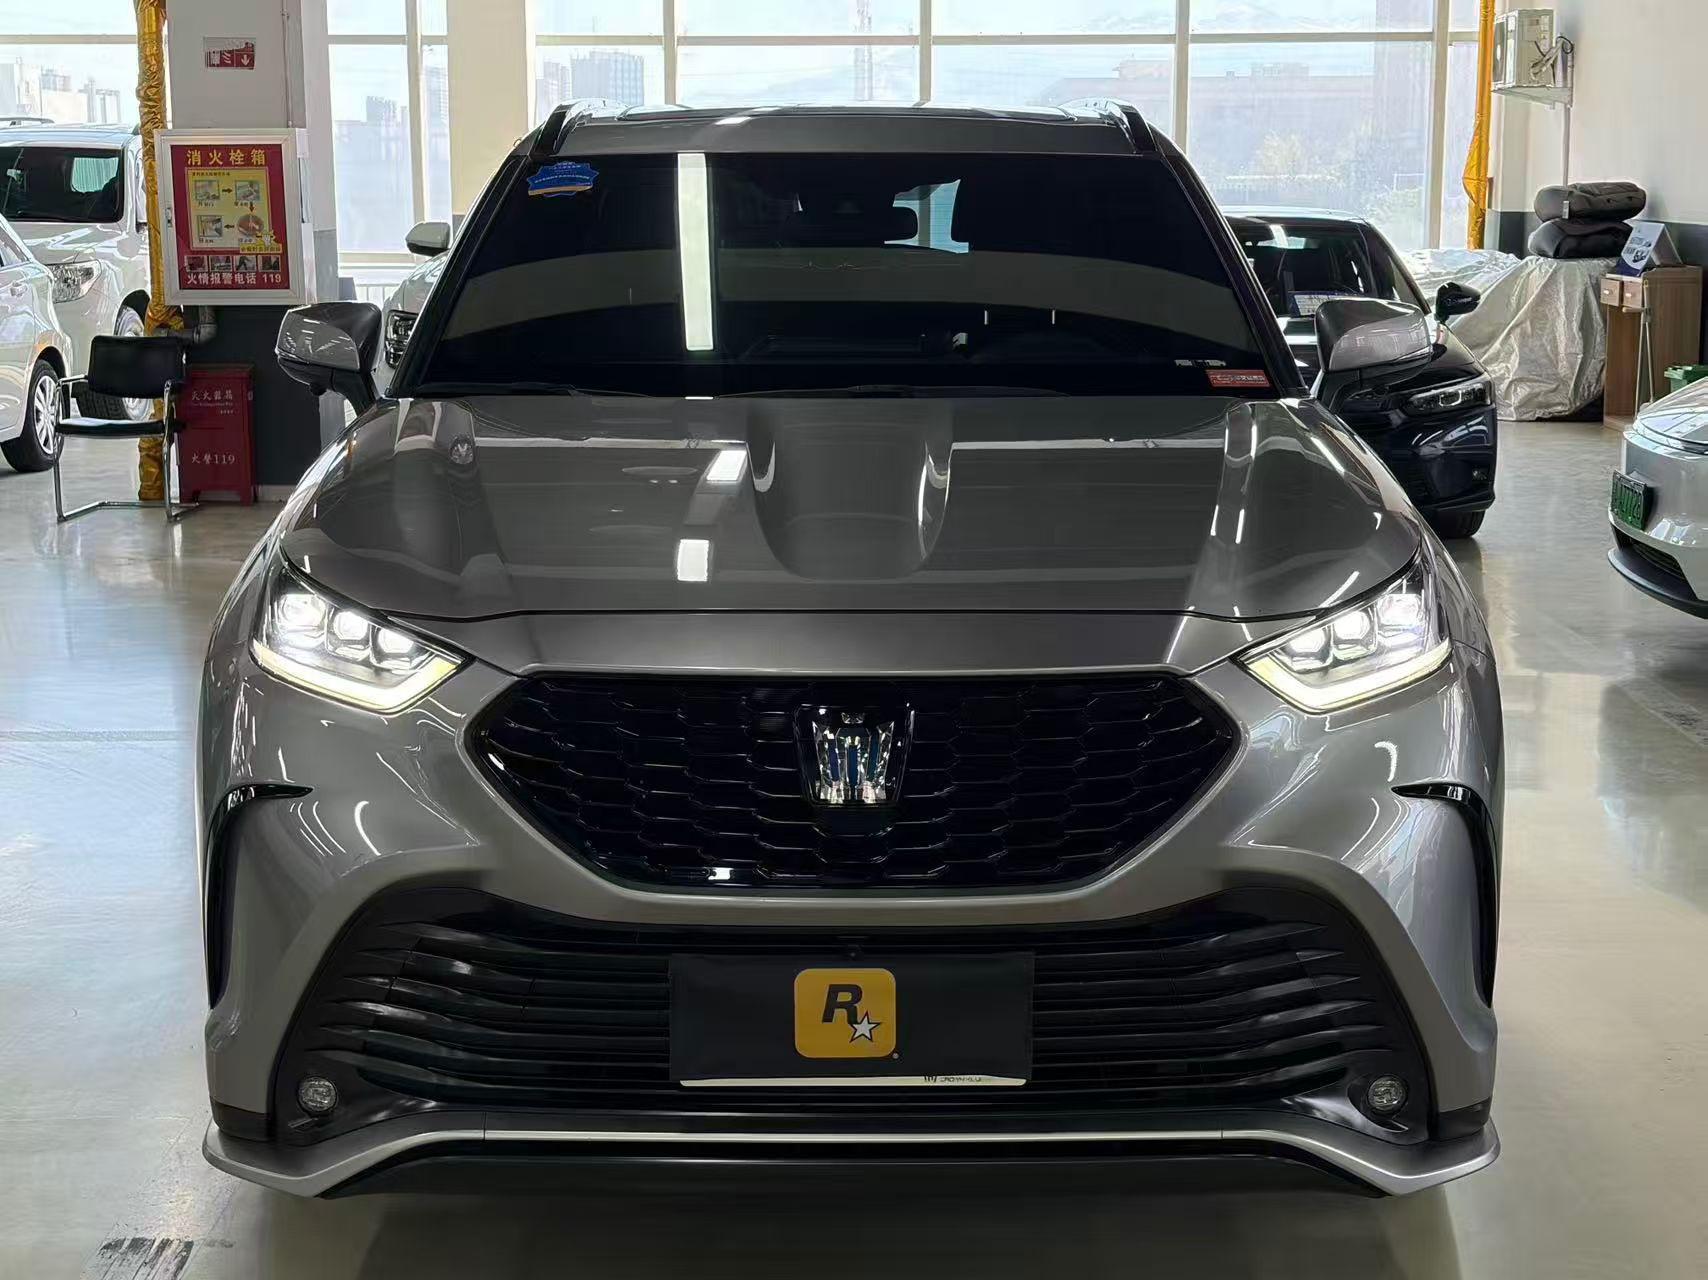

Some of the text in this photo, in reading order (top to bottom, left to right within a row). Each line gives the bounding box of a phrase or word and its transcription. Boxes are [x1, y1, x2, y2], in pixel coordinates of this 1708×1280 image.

[186, 149, 267, 165] 消火栓箱
[187, 273, 282, 285] 火情报警电话 119
[821, 984, 863, 1025] R
